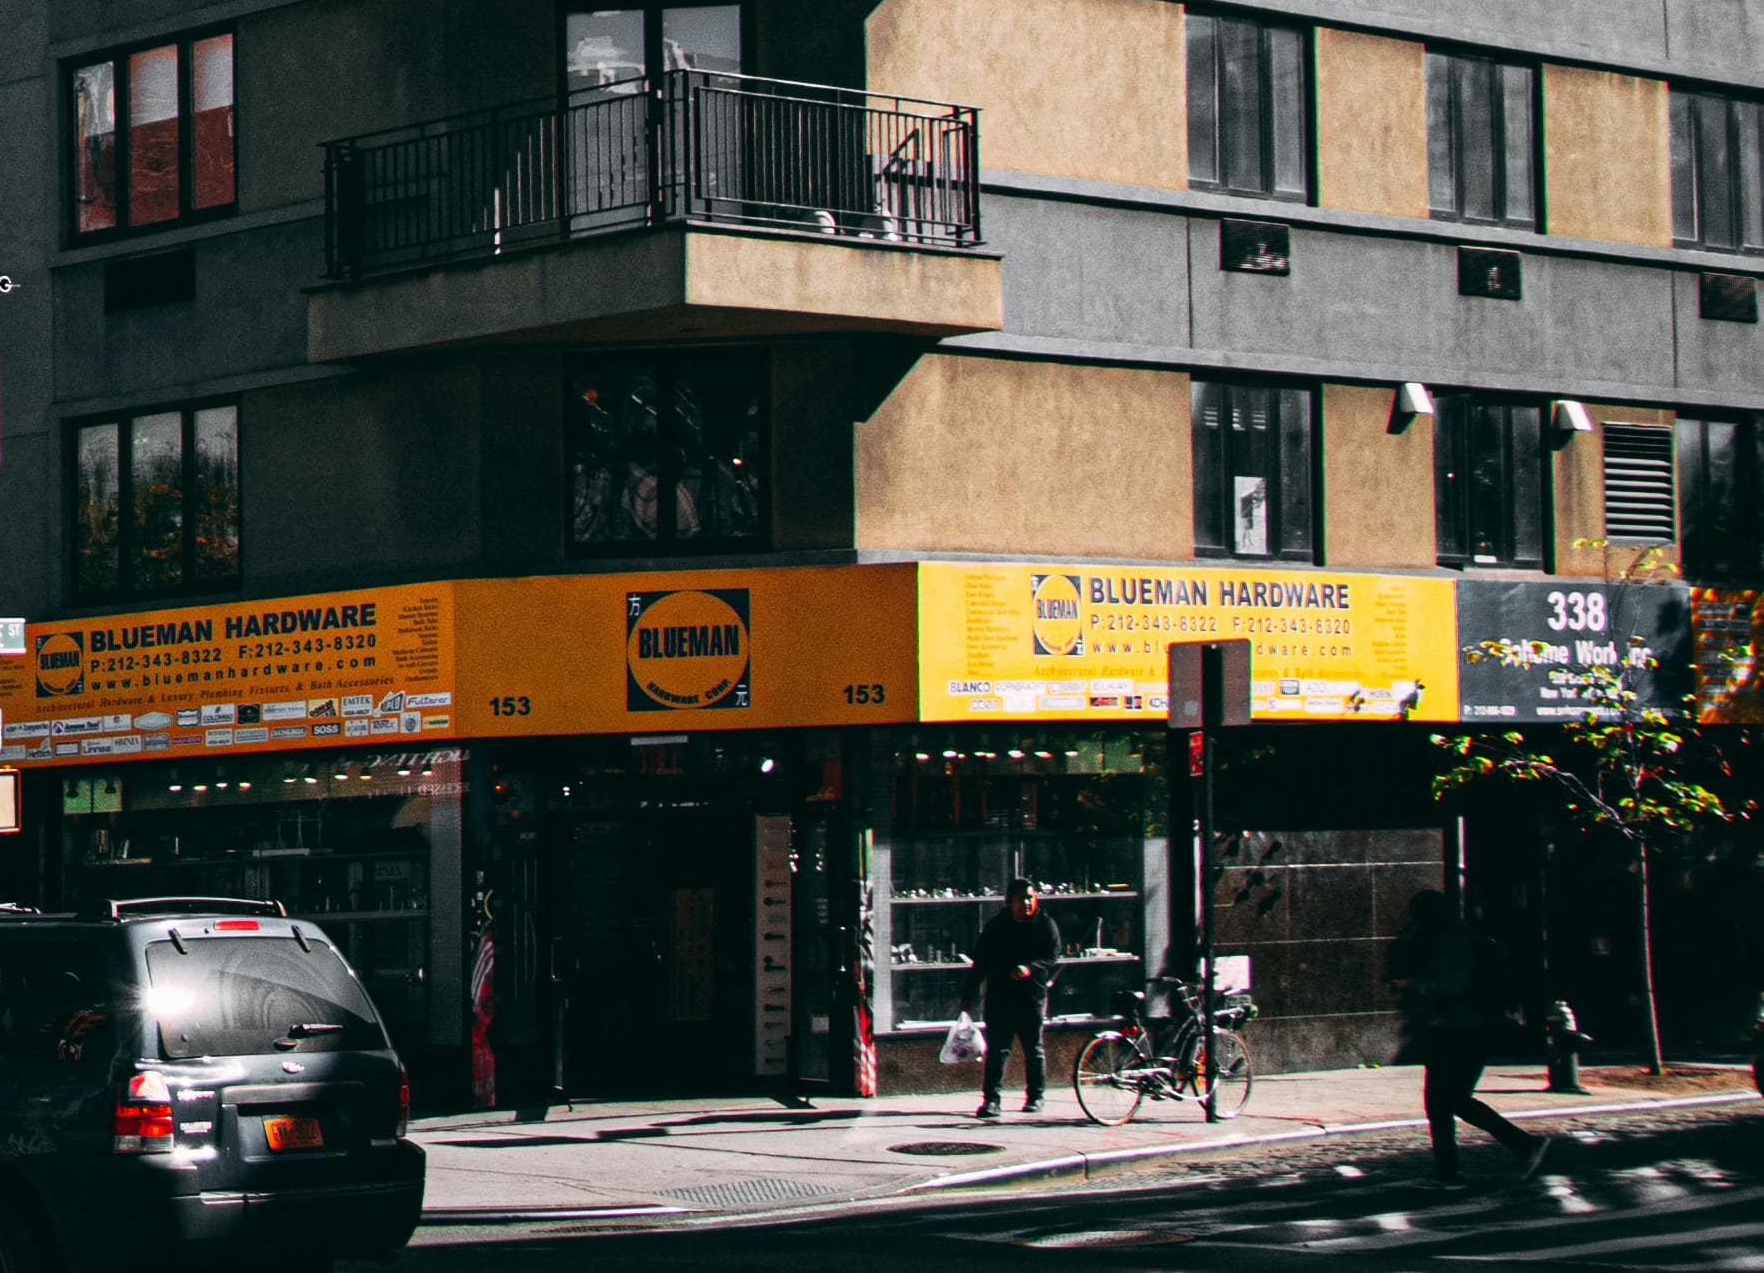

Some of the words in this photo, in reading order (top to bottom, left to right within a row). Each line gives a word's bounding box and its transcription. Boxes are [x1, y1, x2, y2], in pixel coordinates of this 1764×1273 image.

[1090, 577, 1208, 607] BLUEMAN
[1219, 580, 1351, 609] HARDWARE
[628, 593, 642, 617] 方
[1036, 598, 1079, 620] BLUEMAN
[1547, 591, 1607, 631] 338
[8, 623, 21, 637] ST
[90, 618, 213, 653] BLUEMAN
[225, 603, 377, 639] HARDWARE
[1091, 613, 1217, 633] P:212-343-8322
[1233, 616, 1351, 635] F:212-343-8320
[91, 647, 221, 673] P:212-343-8322
[239, 633, 377, 659] F:212-343-8320
[637, 624, 740, 660] BLUEMAN
[39, 649, 81, 671] BLUEMAN
[91, 656, 377, 691] www.bluemanhardware.com
[99, 695, 143, 710] Hardware
[147, 694, 155, 704] &
[160, 690, 194, 704] Luxury
[200, 687, 244, 701] Plumbing
[249, 683, 290, 696] Fixtures
[295, 682, 304, 691] &
[310, 679, 333, 691] Bath
[336, 675, 395, 688] Accessories
[646, 680, 700, 706] HARDWARE
[735, 684, 748, 707] 元
[843, 684, 886, 706] 153
[950, 681, 992, 693] BLANCO
[489, 696, 532, 718] 153
[313, 724, 339, 736] SOSS
